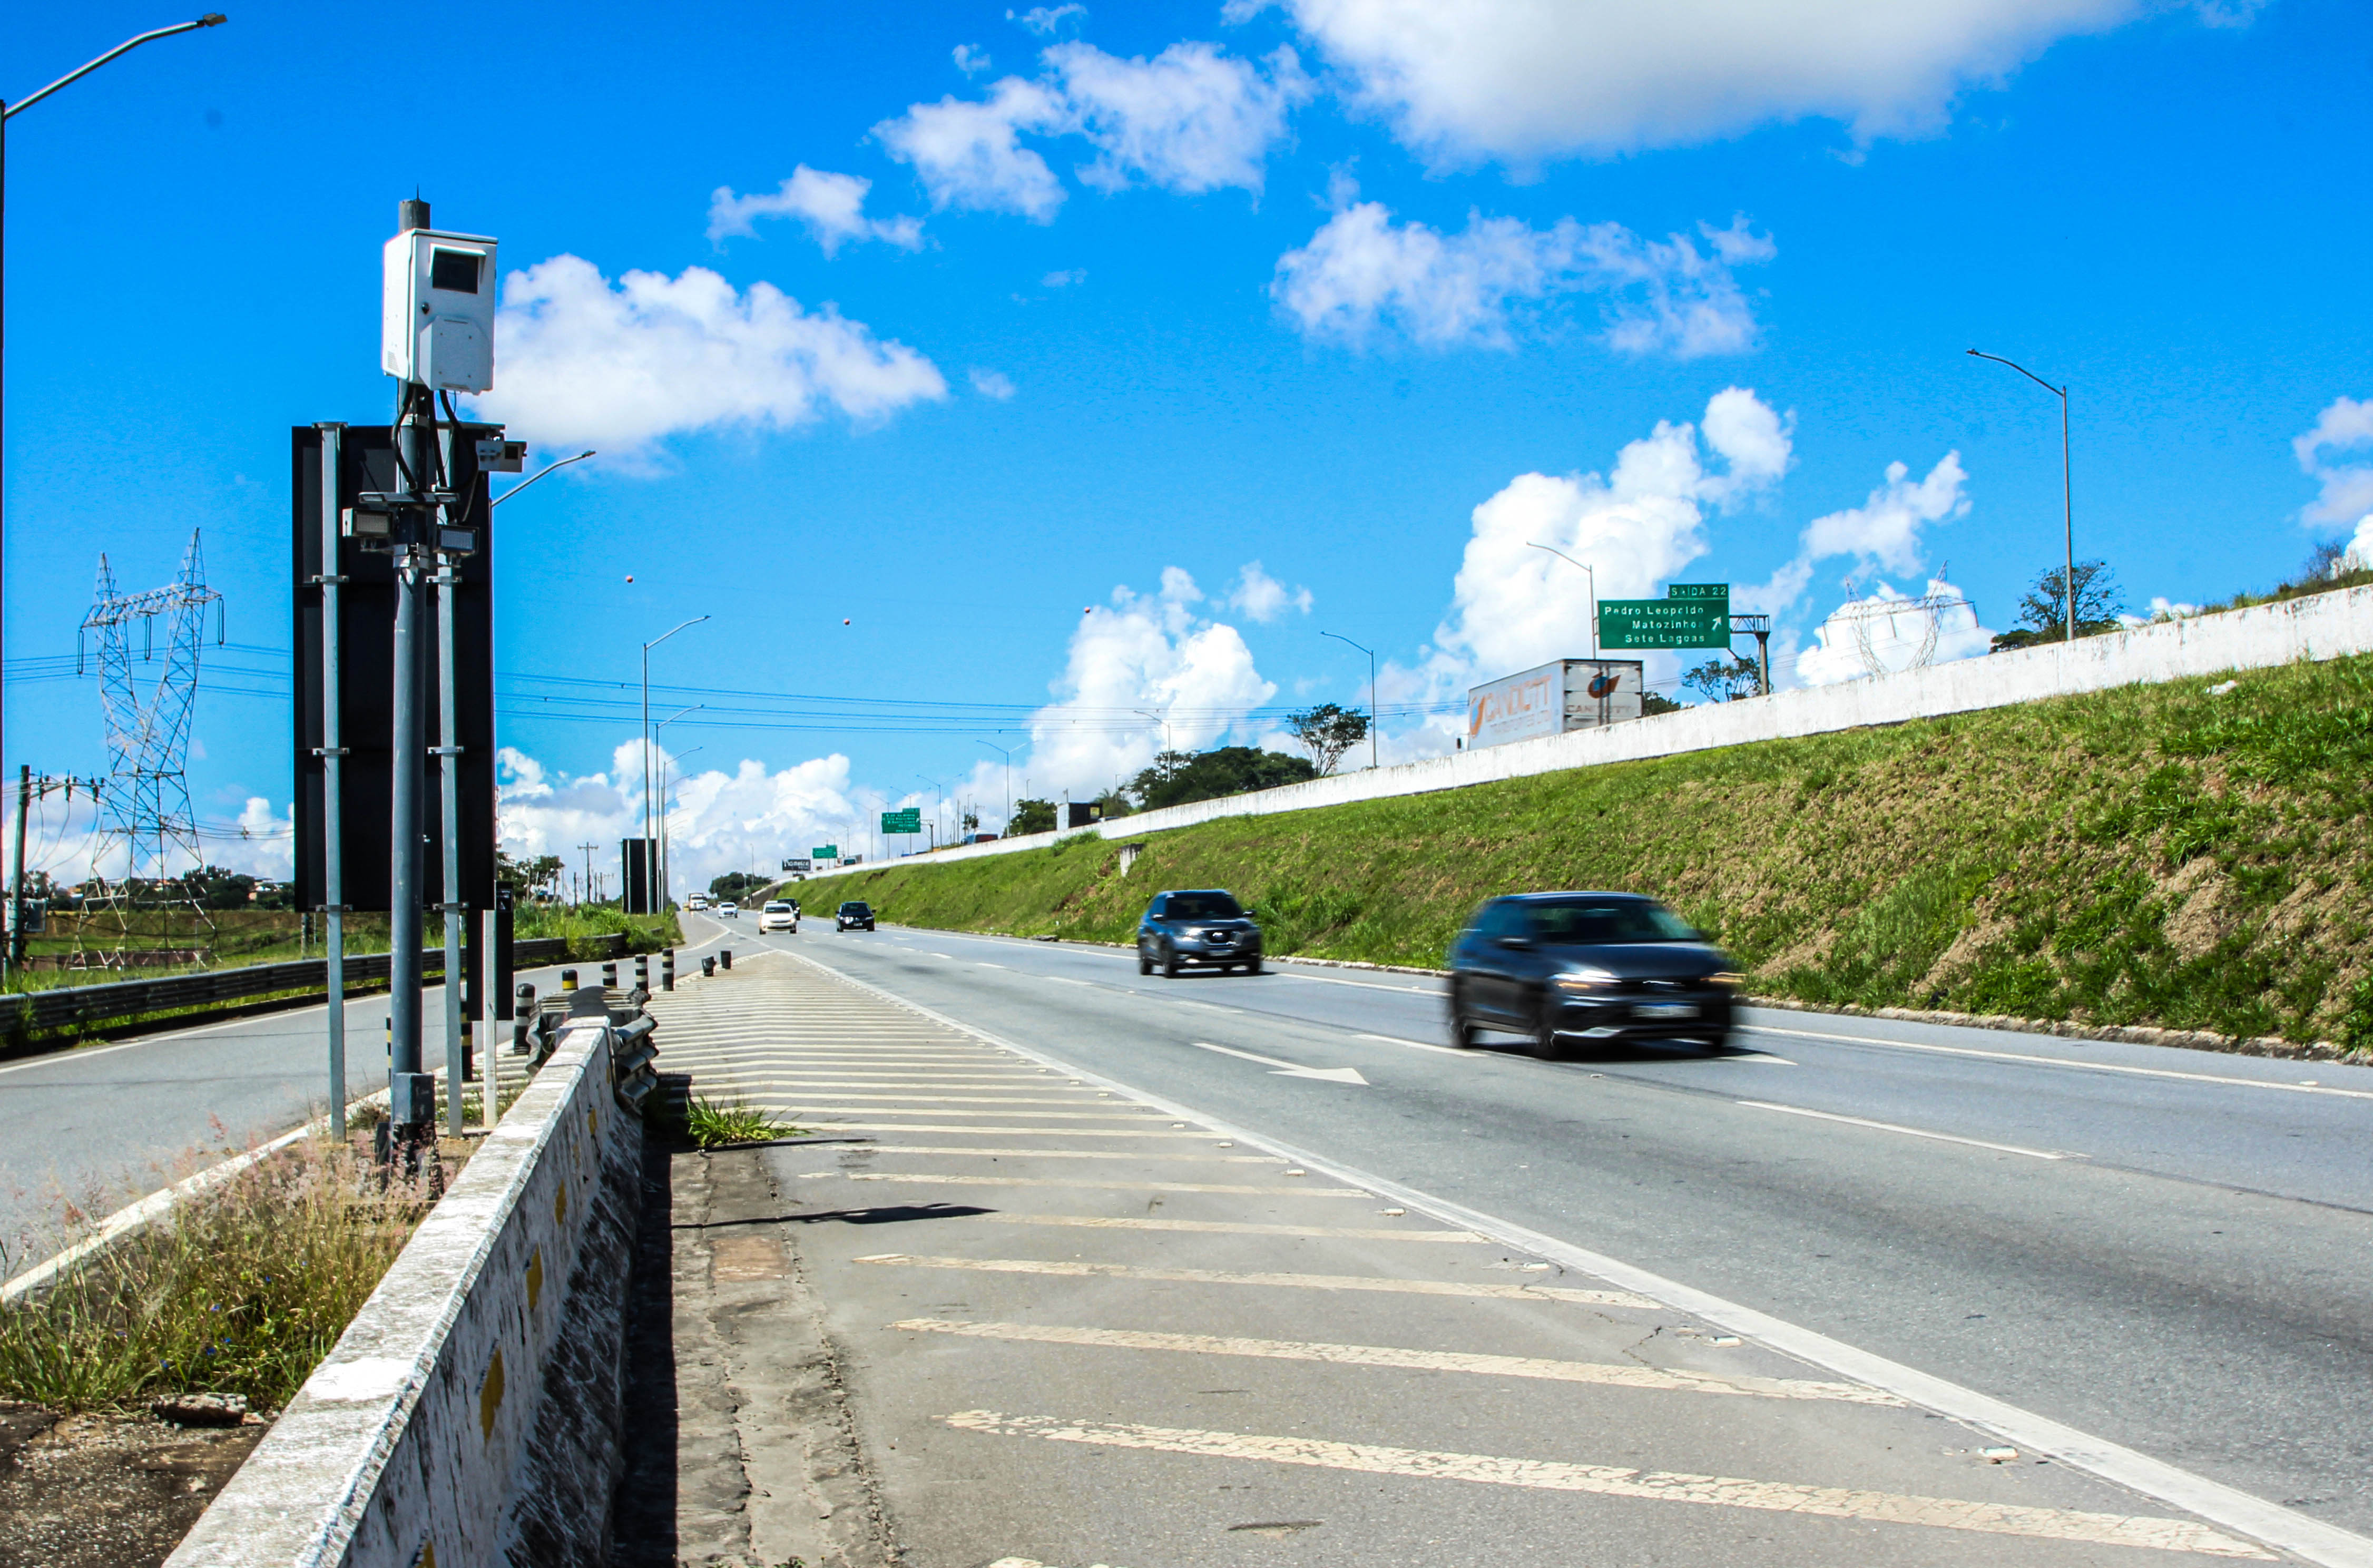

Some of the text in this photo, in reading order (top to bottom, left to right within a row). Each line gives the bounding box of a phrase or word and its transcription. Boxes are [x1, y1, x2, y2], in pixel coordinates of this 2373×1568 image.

[1712, 586, 1727, 596] 22
[1604, 606, 1641, 615] Pedro
[1625, 634, 1705, 645] Sete Lagoas
